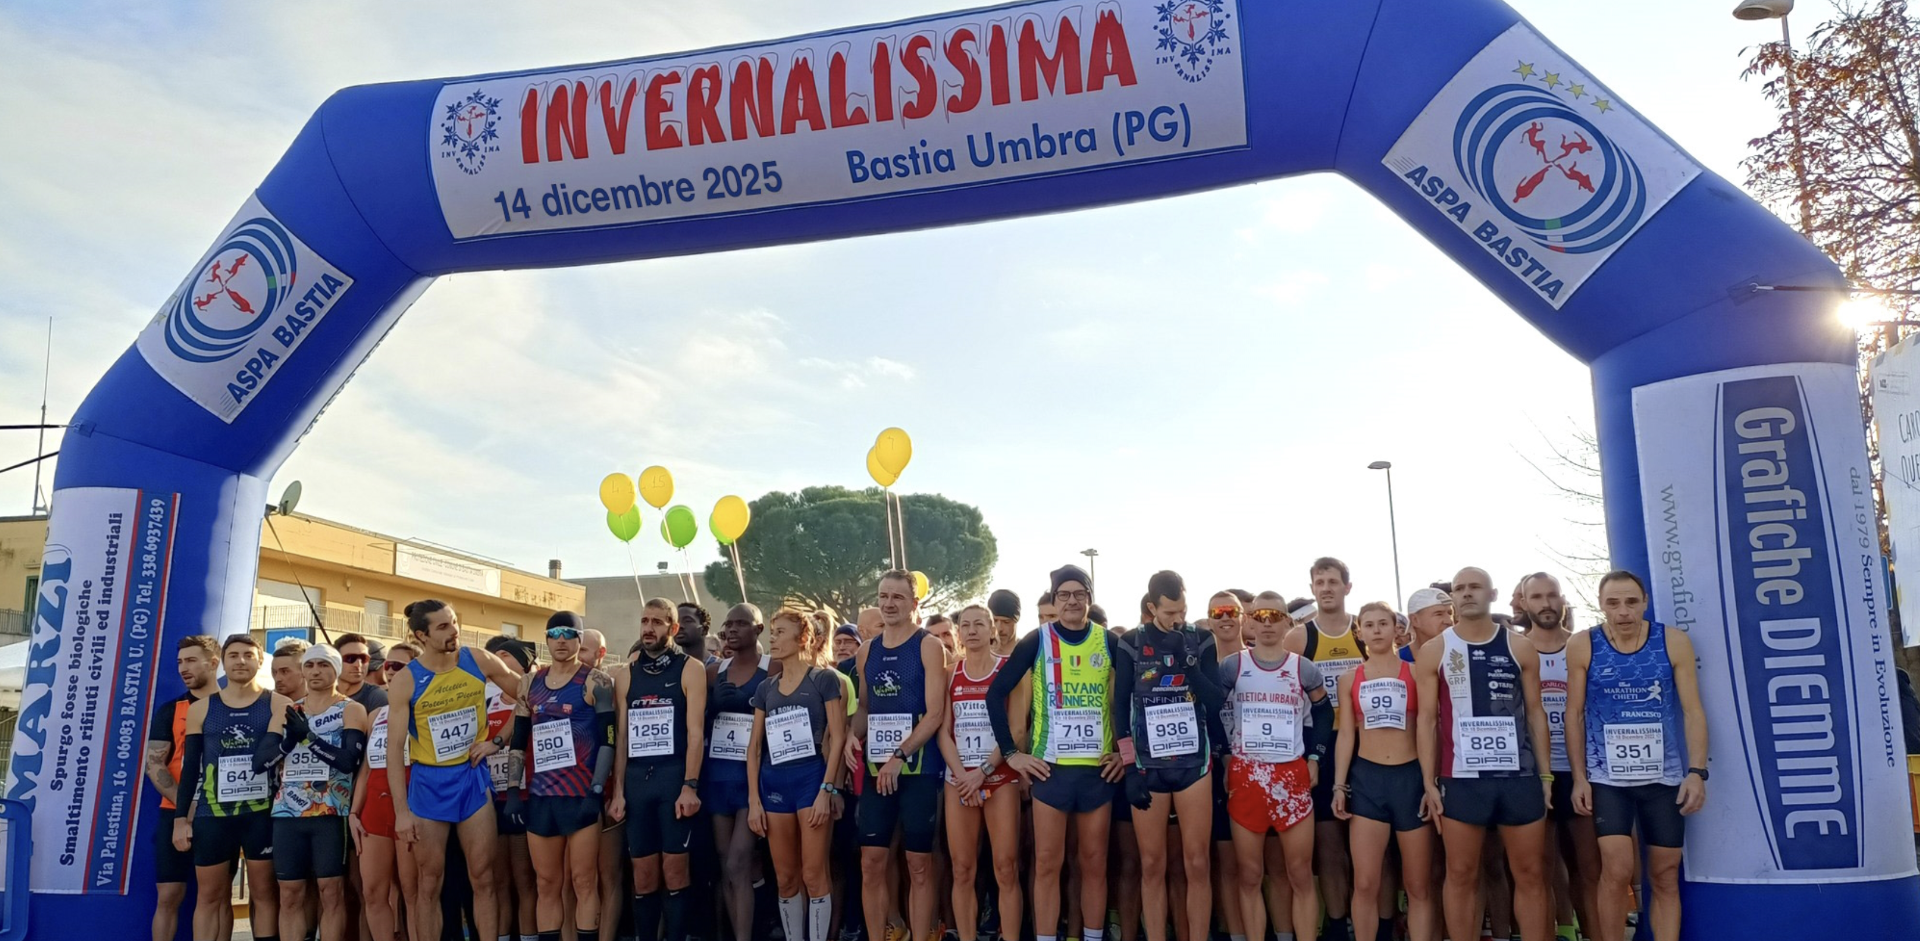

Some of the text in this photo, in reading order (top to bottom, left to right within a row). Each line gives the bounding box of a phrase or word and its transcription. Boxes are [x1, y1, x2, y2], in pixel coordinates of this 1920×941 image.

[520, 6, 1138, 165] INVERNALISSIMA
[846, 102, 1192, 184] Bastia Umbra (PG)
[493, 161, 785, 222] 14 dicembre 2025
[1404, 165, 1565, 301] ASPA BASTIA
[226, 272, 344, 404] ASPA BASTIA
[1901, 453, 1920, 489] QUE
[1734, 406, 1813, 606] Grafiche
[142, 498, 166, 579] 338.6937439
[136, 580, 154, 605] Tel.
[129, 608, 151, 640] (PG)
[1850, 466, 1896, 769] dal 1979 Sempre in Evoluzione
[128, 642, 145, 658] U.
[7, 557, 72, 815] MARZI
[50, 580, 93, 792] Spurgo fosse biologiche
[1448, 676, 1467, 685] GRP
[59, 512, 123, 866] Smaltimento rifiuti civili ed industriali
[121, 660, 143, 717] BASTIA
[434, 681, 468, 696] Atletica
[1046, 682, 1105, 695] CAIVANO
[961, 702, 986, 710] Vitto
[1048, 695, 1103, 708] RUNNERS
[1371, 695, 1393, 709] 99
[1366, 714, 1402, 723] DIPA
[440, 722, 469, 740] 447
[632, 723, 670, 737] 1256
[726, 730, 735, 742] 4
[783, 730, 792, 742] 5
[875, 730, 903, 742] 668
[1062, 724, 1094, 737] 716
[1156, 722, 1188, 737] 936
[1261, 722, 1272, 736] 9
[117, 718, 137, 760] 06083
[536, 736, 564, 752] 560
[631, 741, 669, 750] DIPA
[965, 736, 981, 749] 11
[1152, 740, 1194, 751] DIPA
[1244, 741, 1288, 750] DIPA
[1470, 736, 1507, 750] 826
[712, 745, 746, 755] DIPA
[772, 744, 809, 758] DIPA
[1615, 744, 1652, 758] 351
[291, 752, 320, 765] 358
[1465, 756, 1513, 764] DIPA
[1611, 765, 1659, 773] DIPA
[112, 770, 128, 788] 16
[226, 770, 256, 783] 647
[221, 786, 263, 794] DIPA
[100, 790, 128, 859] Palestina,
[96, 862, 115, 887] Via
